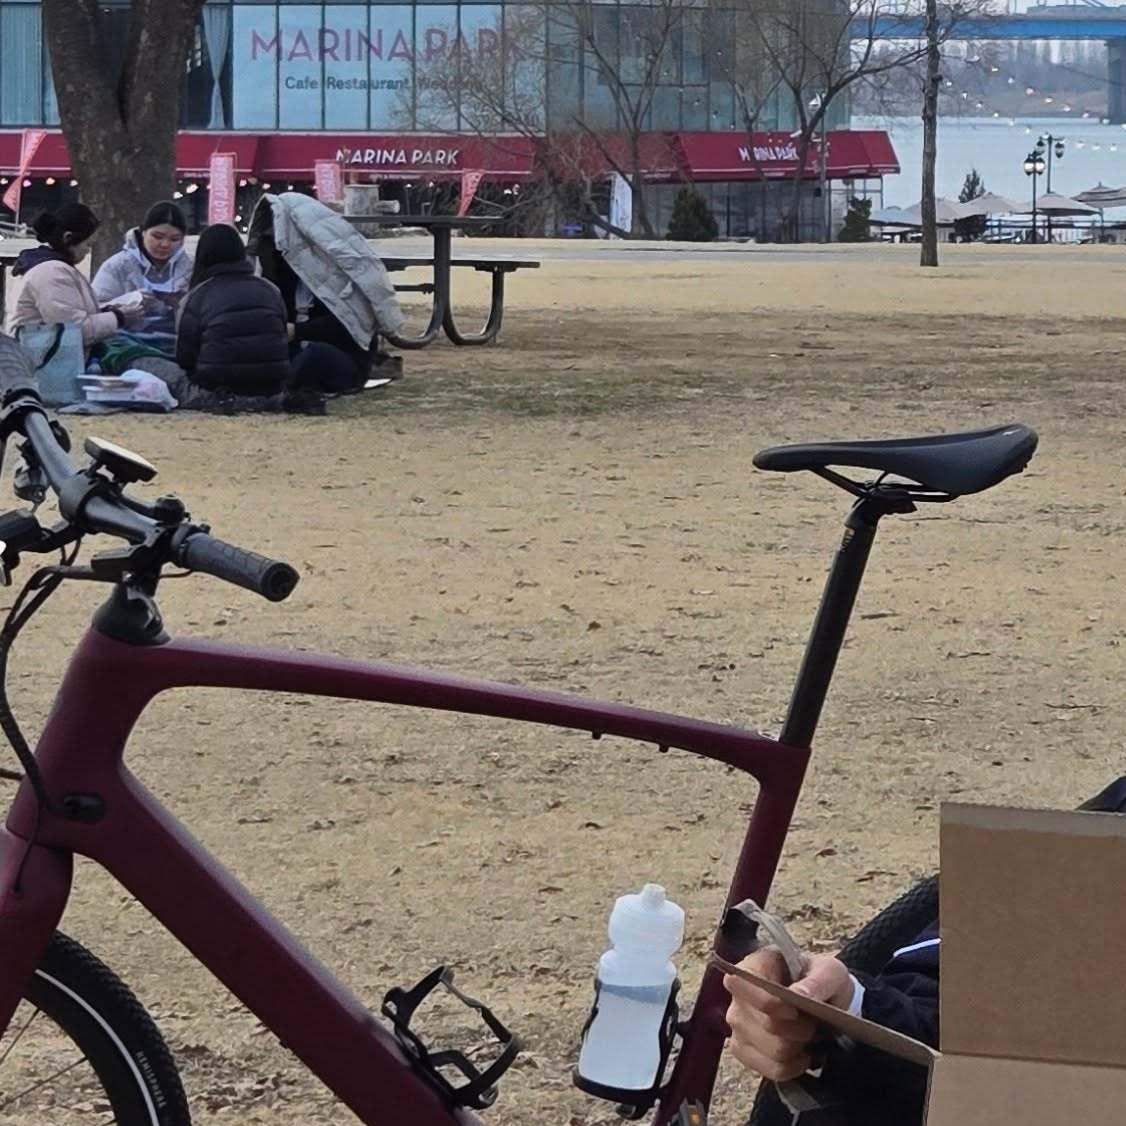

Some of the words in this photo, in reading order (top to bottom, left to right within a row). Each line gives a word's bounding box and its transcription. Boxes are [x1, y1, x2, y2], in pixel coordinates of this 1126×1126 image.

[251, 28, 415, 62] MARINA
[284, 76, 318, 91] Cafe
[326, 76, 410, 91] Restaurant
[411, 149, 459, 165] PARK
